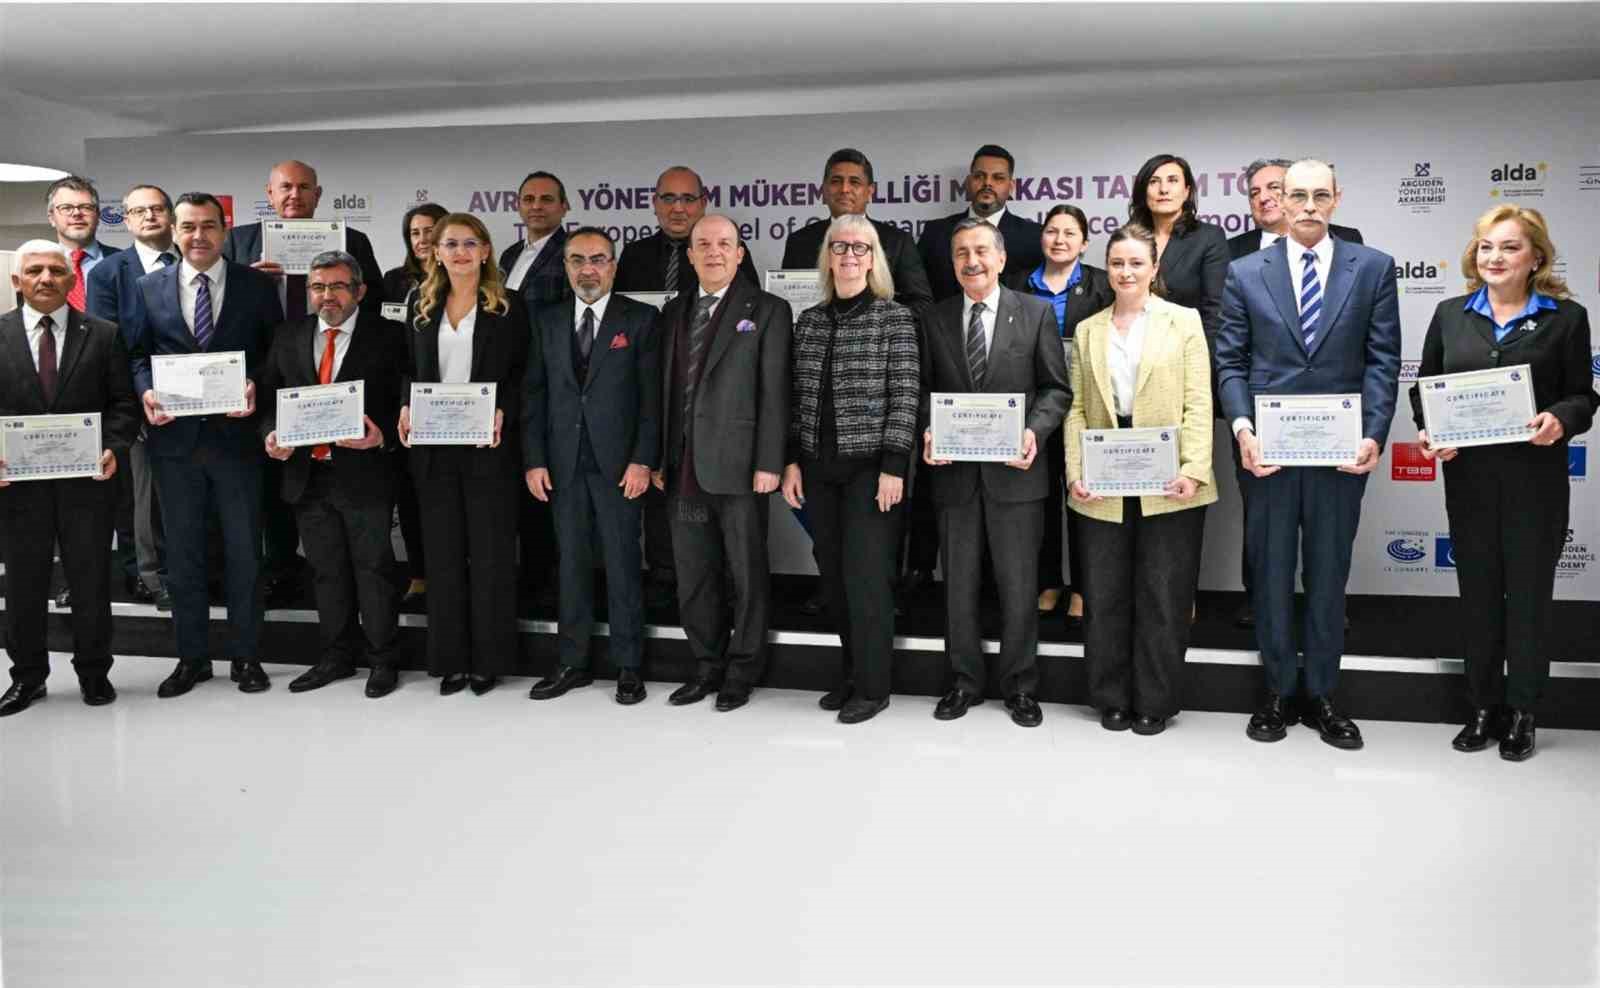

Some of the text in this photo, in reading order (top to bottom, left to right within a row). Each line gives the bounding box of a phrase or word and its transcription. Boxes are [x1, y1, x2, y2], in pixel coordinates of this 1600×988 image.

[1490, 163, 1537, 182] alda
[949, 176, 1083, 202] MKASI
[333, 194, 366, 209] alda
[769, 217, 796, 240] of
[1395, 261, 1437, 279] alda
